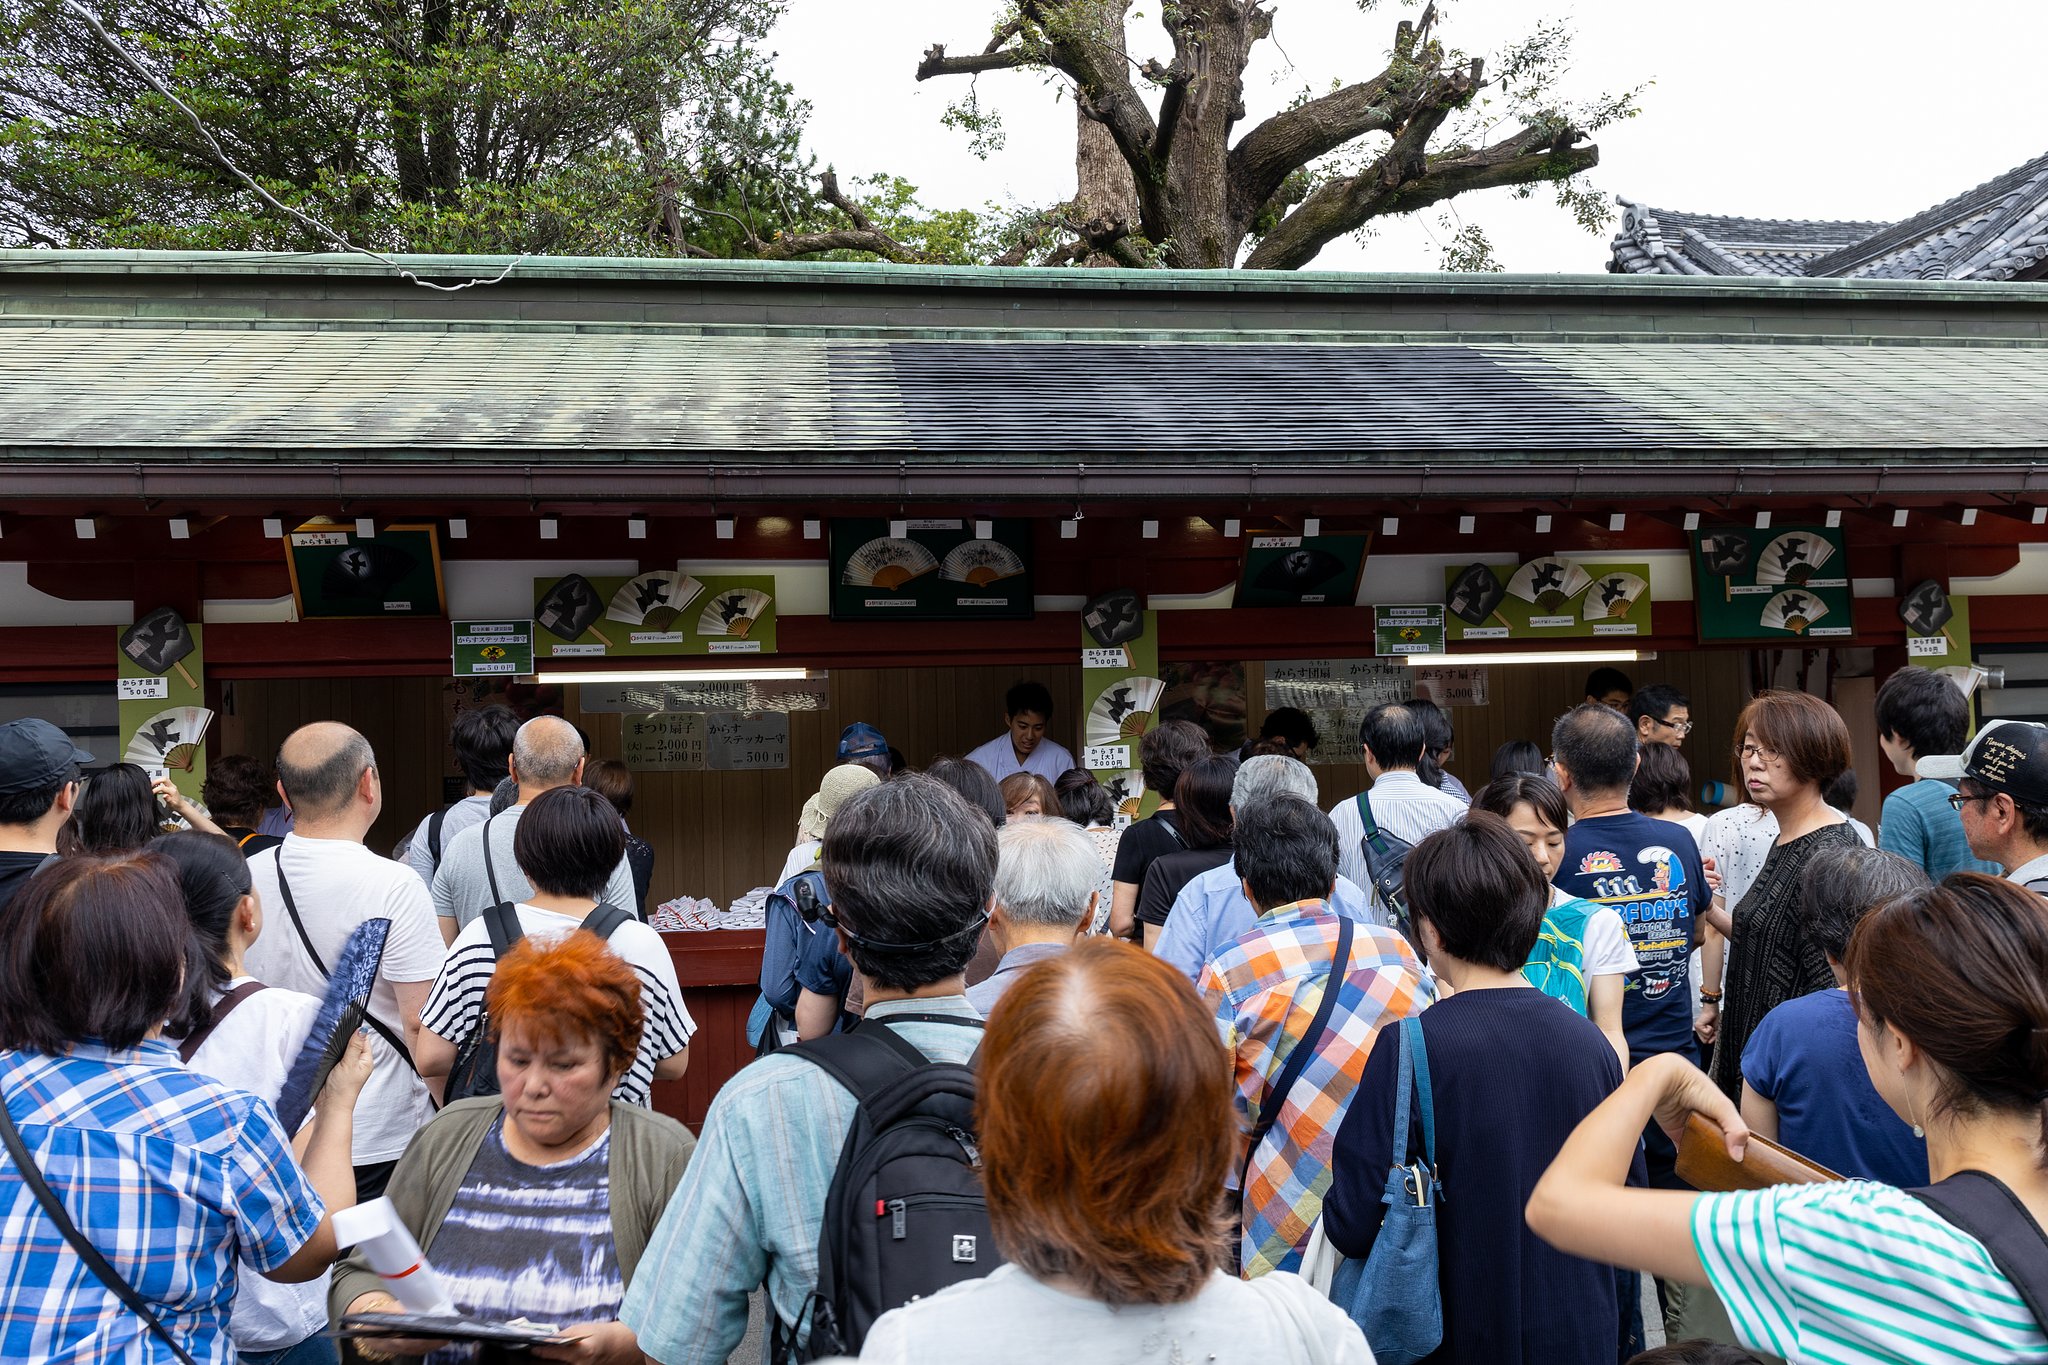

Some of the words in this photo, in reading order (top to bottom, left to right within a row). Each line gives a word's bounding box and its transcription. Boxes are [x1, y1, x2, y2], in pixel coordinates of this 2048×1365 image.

[1275, 667, 1331, 679] からす団扇
[1421, 668, 1481, 680] からす扇子
[122, 678, 160, 686] からす団扇
[130, 688, 156, 696] 500円
[633, 722, 695, 735] まつり扇子
[709, 723, 742, 735] からす
[723, 734, 786, 745] ステッカー守
[627, 741, 642, 751] (大)
[657, 740, 701, 751] 2,000円
[627, 753, 643, 763] (小)
[658, 751, 701, 762] 1,500円
[746, 752, 784, 762] 500円
[1094, 759, 1123, 767] 2000円
[1640, 897, 1688, 922] DAY'S
